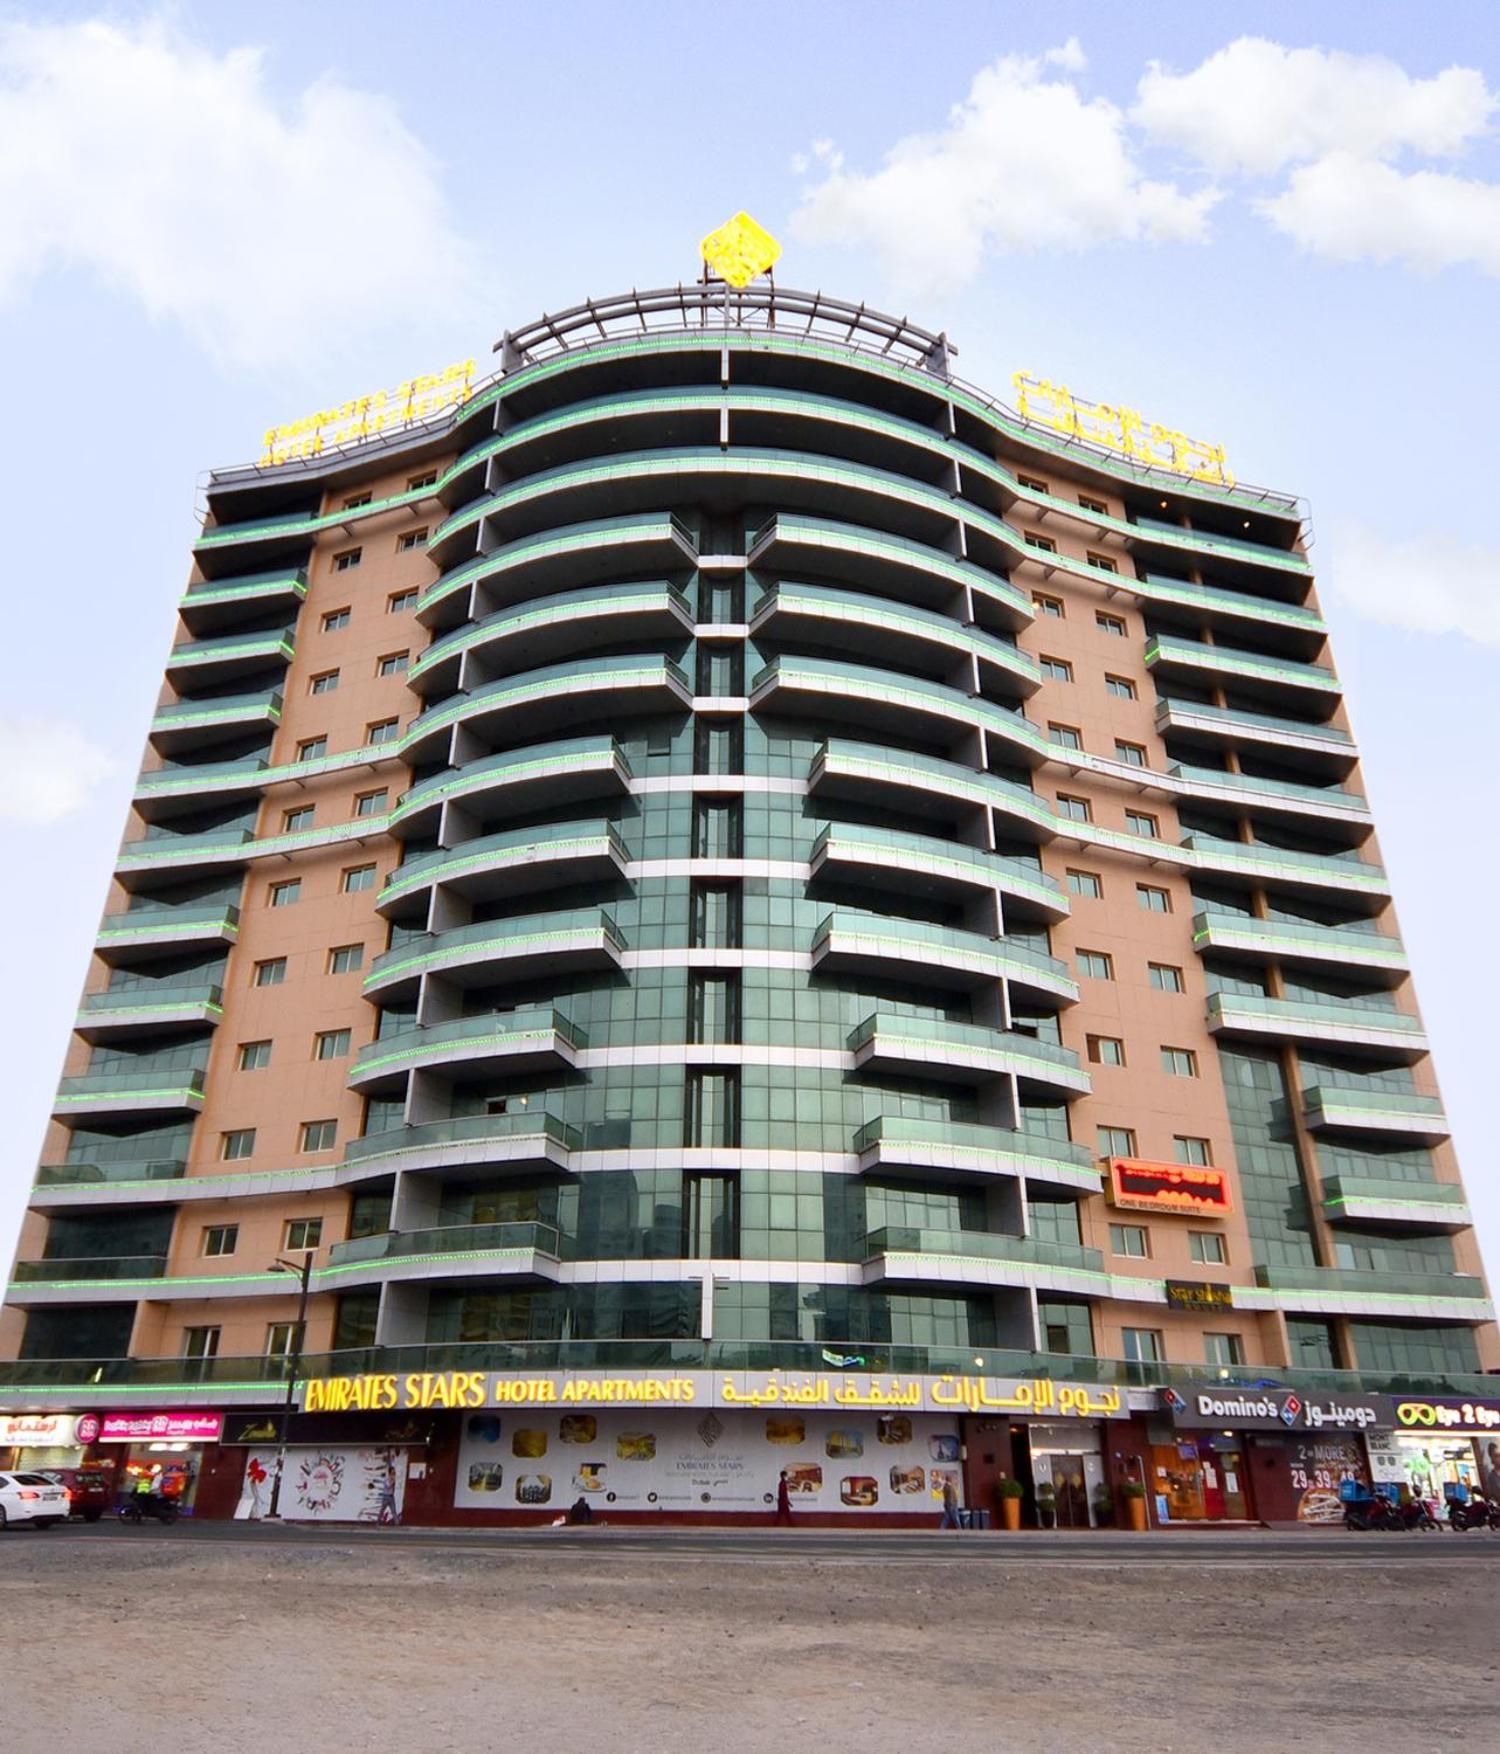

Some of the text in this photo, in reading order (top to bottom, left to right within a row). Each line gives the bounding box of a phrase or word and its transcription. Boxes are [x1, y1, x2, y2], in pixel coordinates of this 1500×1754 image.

[304, 1372, 695, 1412] EMIRATES STARS HOTEL APARTMENTS
[1198, 1395, 1278, 1418] Domino's
[1461, 1403, 1475, 1424] 2
[1291, 1469, 1308, 1489] 29
[1314, 1469, 1331, 1489] 39
